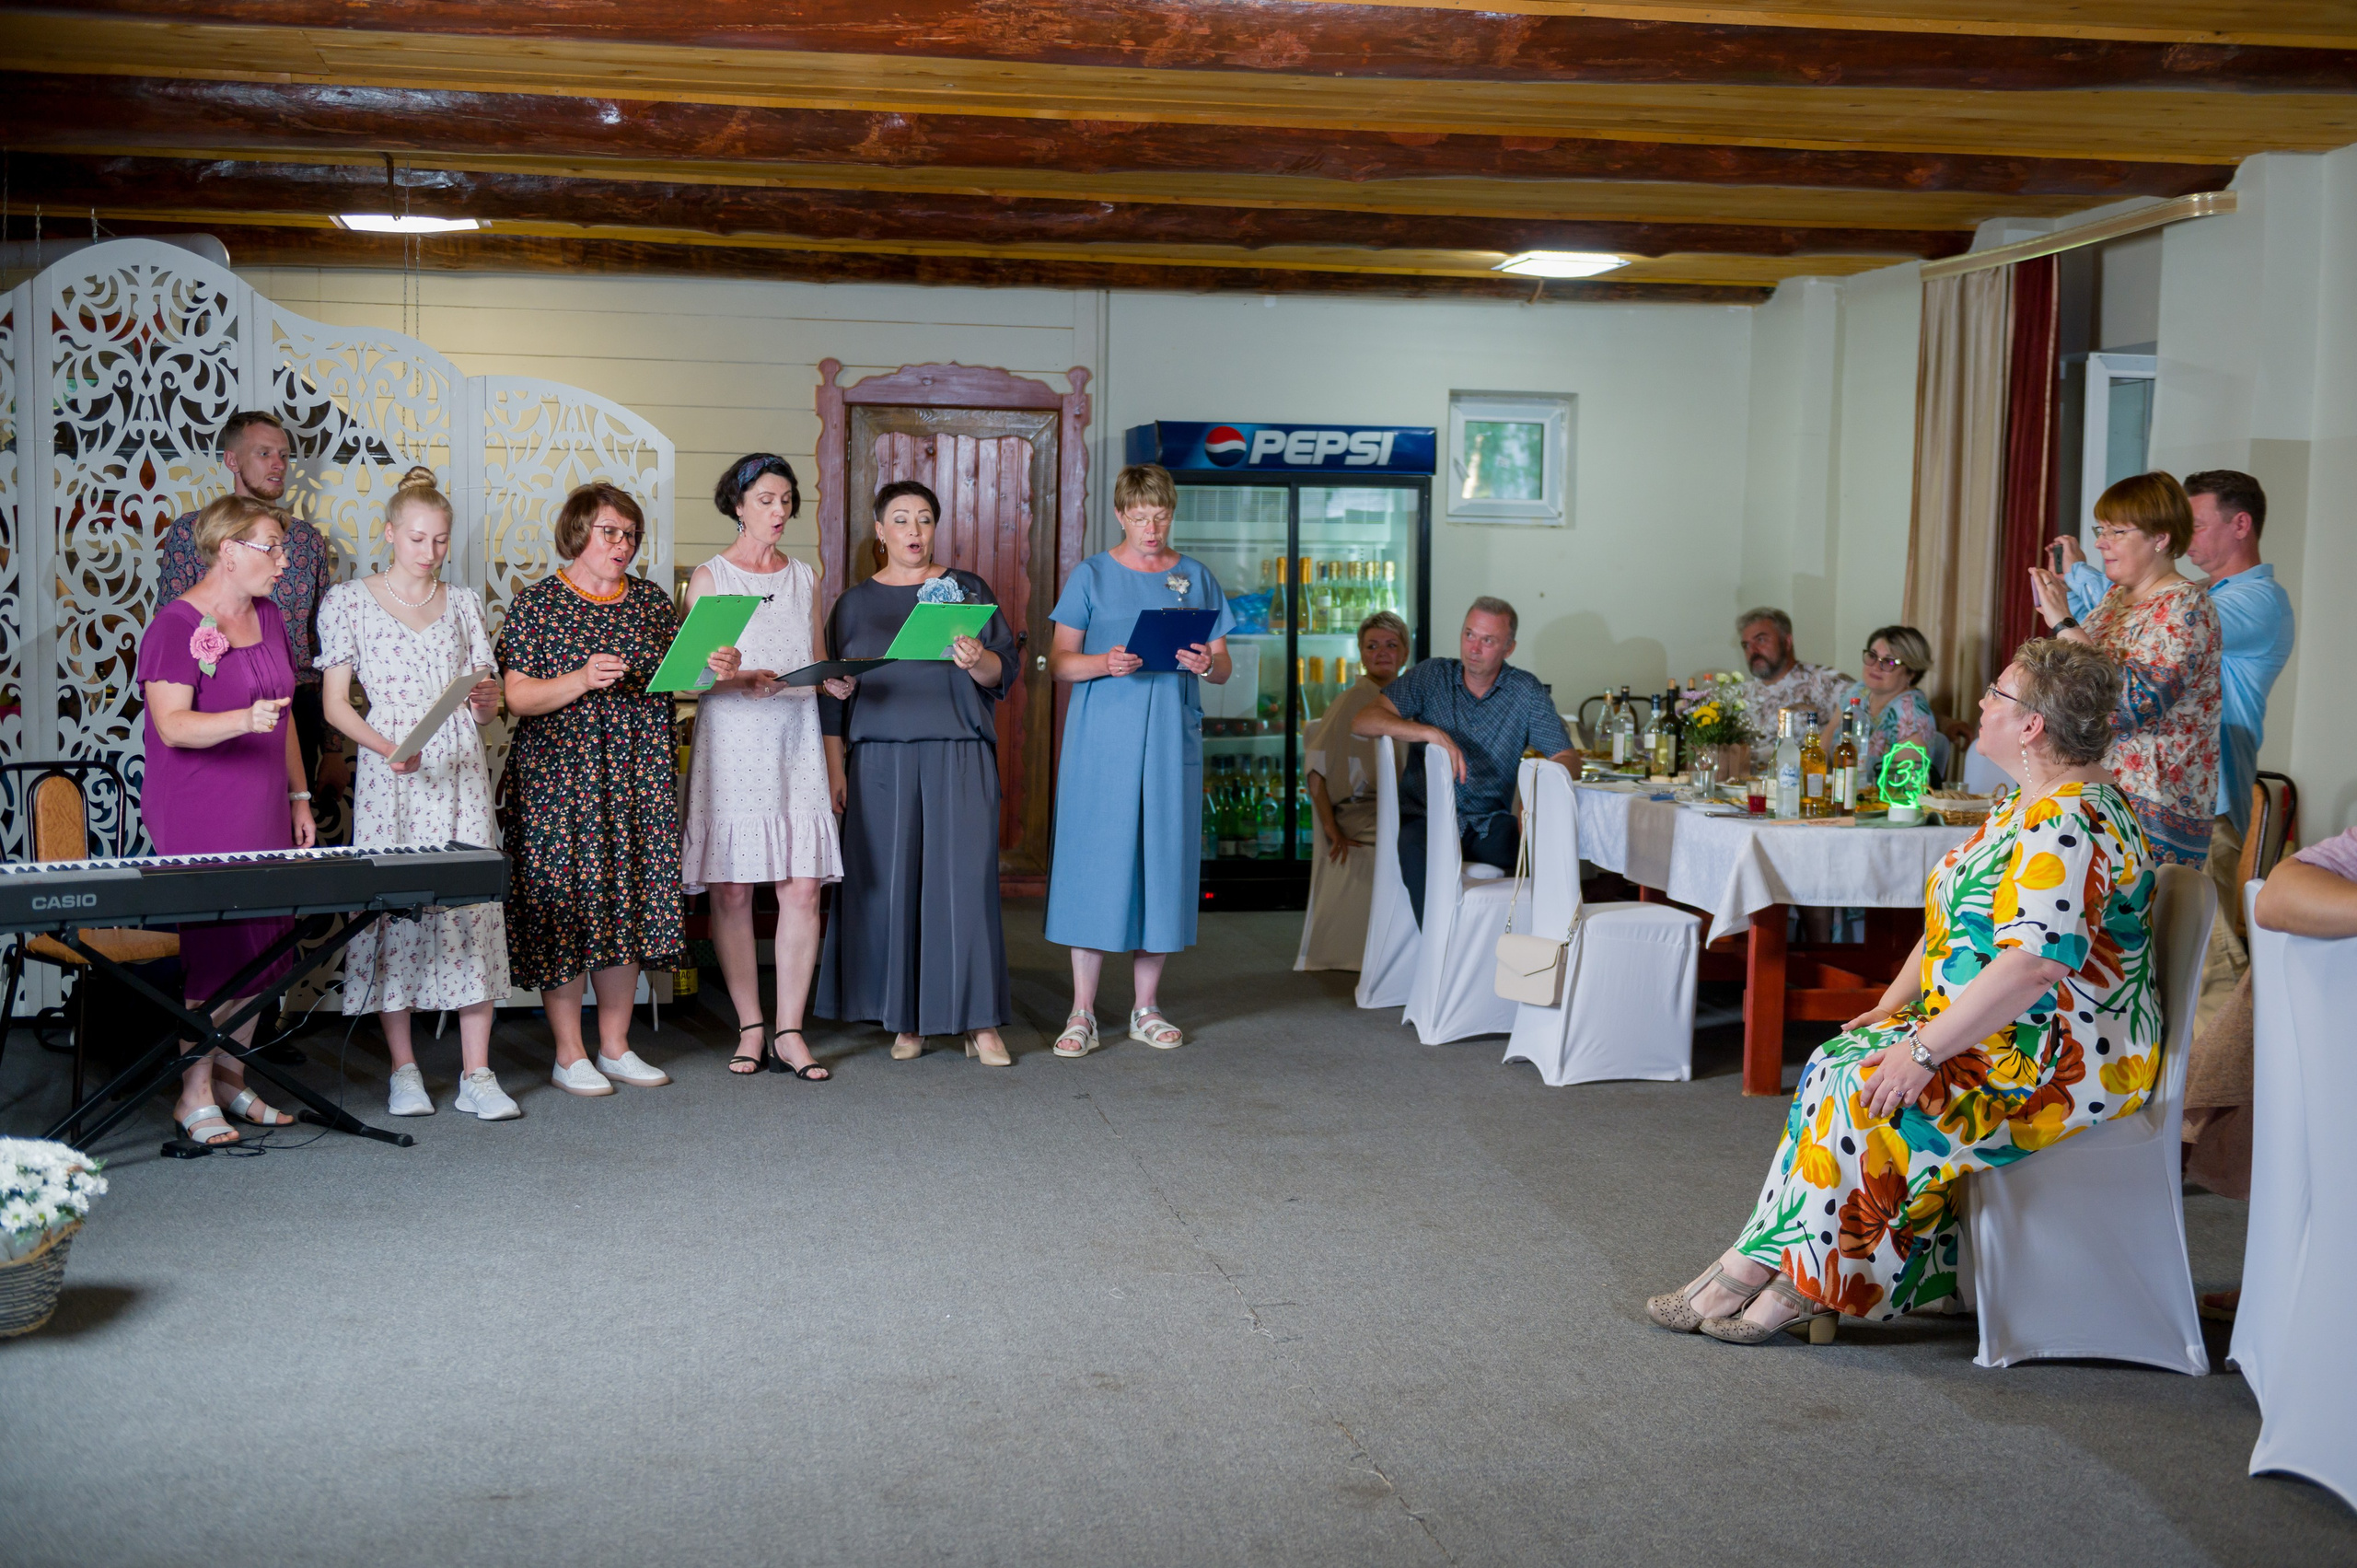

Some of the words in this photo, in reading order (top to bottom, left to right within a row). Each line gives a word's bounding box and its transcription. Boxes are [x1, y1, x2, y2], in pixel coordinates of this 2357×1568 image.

[1248, 429, 1395, 466] PEPSI
[1887, 759, 1915, 787] 3
[31, 893, 97, 910] CASIO
